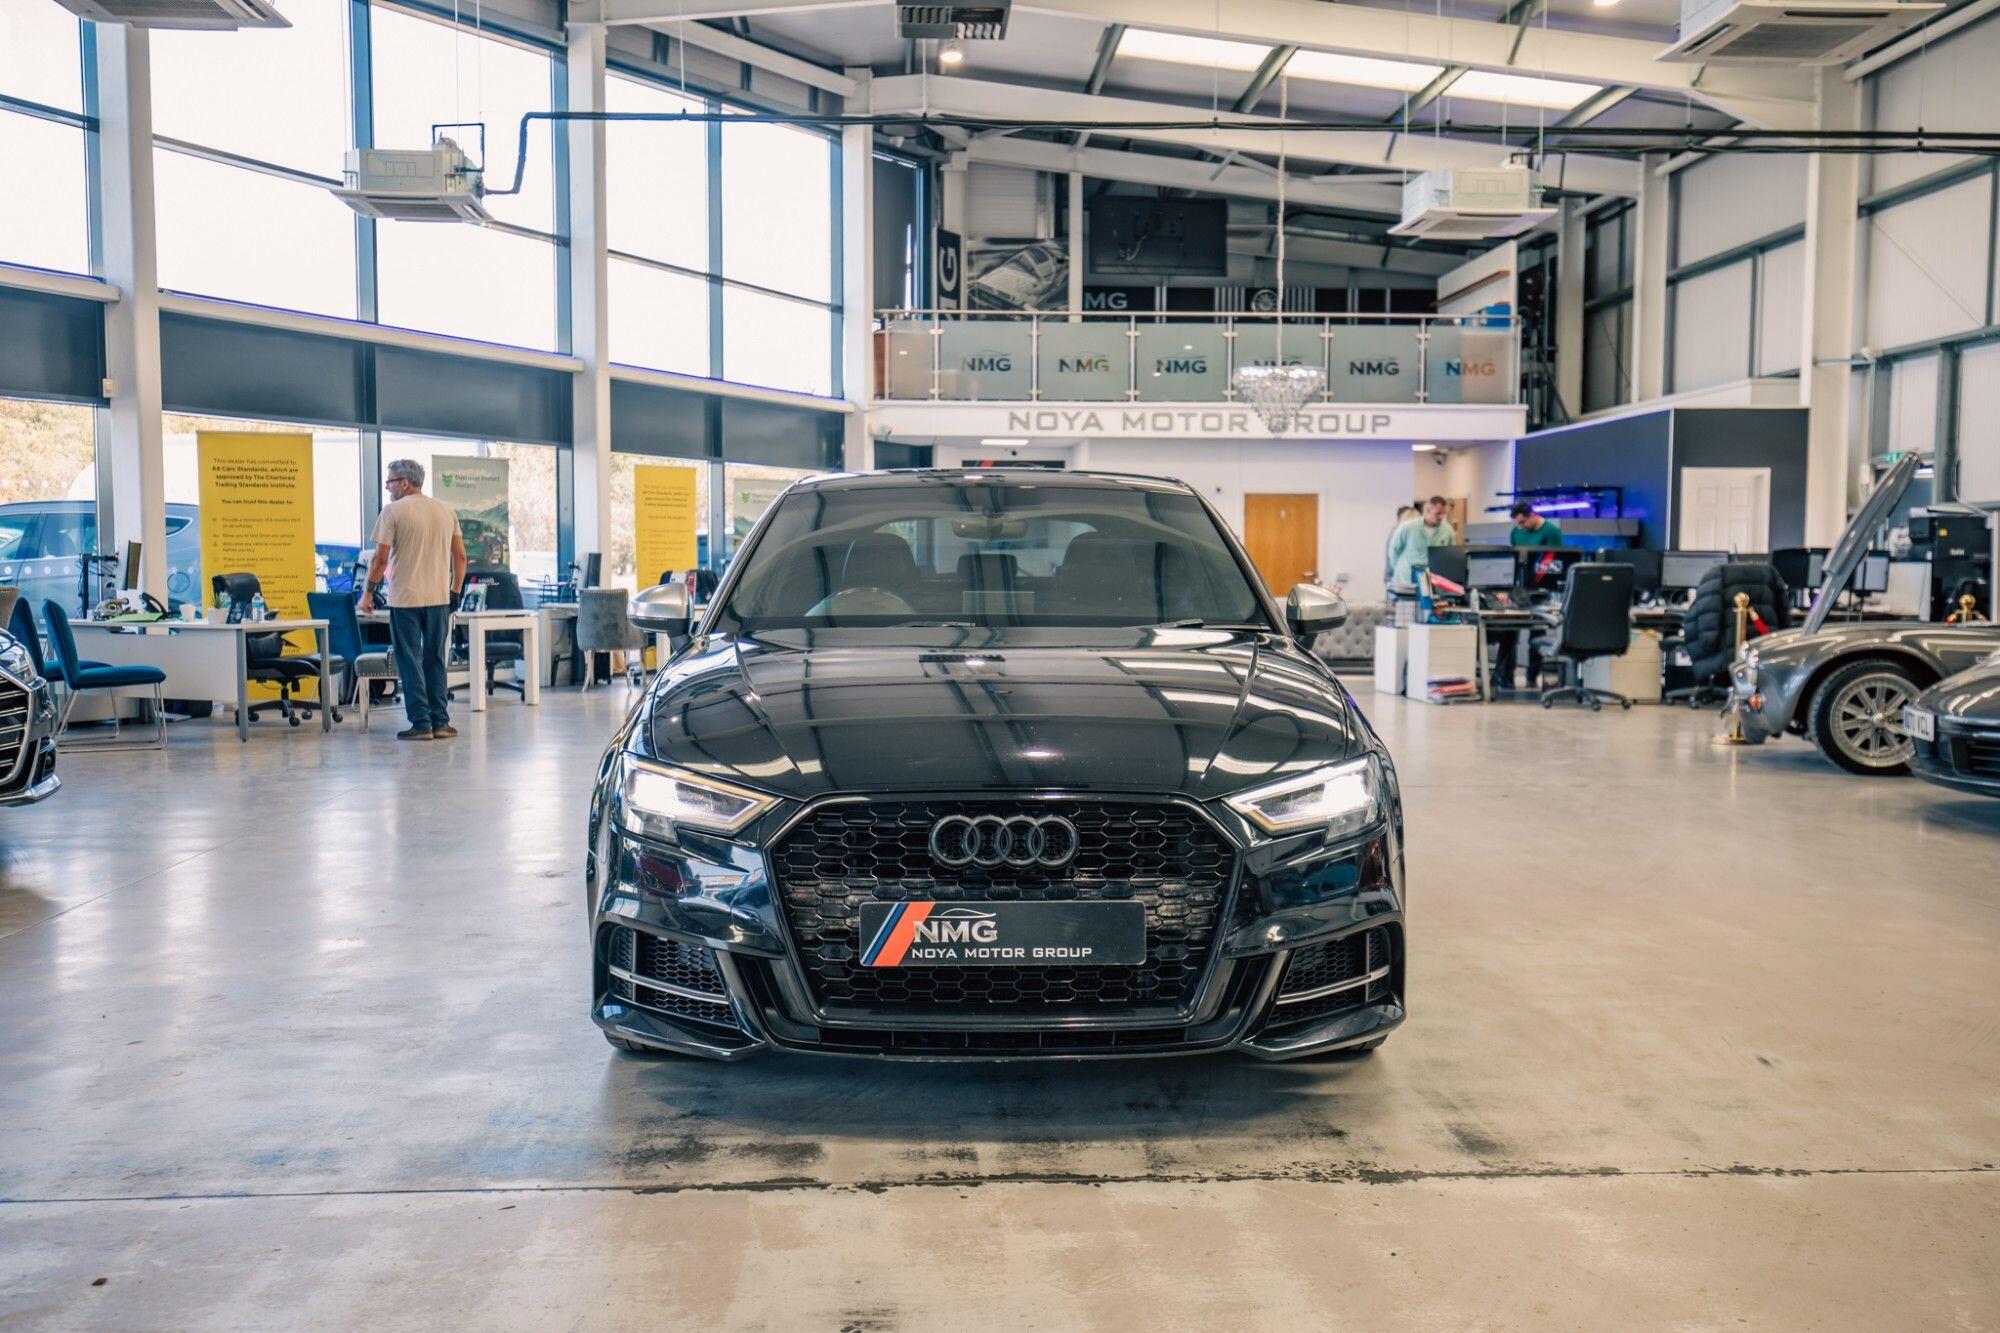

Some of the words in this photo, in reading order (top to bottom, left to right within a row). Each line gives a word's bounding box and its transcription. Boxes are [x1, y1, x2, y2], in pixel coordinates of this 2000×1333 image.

[962, 357, 1011, 372] NMG
[1058, 359, 1110, 373] NMG
[1156, 359, 1207, 374] NMG
[1349, 361, 1400, 376] NMG
[1445, 361, 1496, 376] NMG
[1008, 411, 1104, 432] NOYA
[1122, 412, 1249, 433] MOTOR
[913, 920, 998, 943] NMG
[911, 948, 957, 959] NOYA
[964, 947, 1026, 958] MOTOR
[1032, 947, 1092, 958] GROUP
